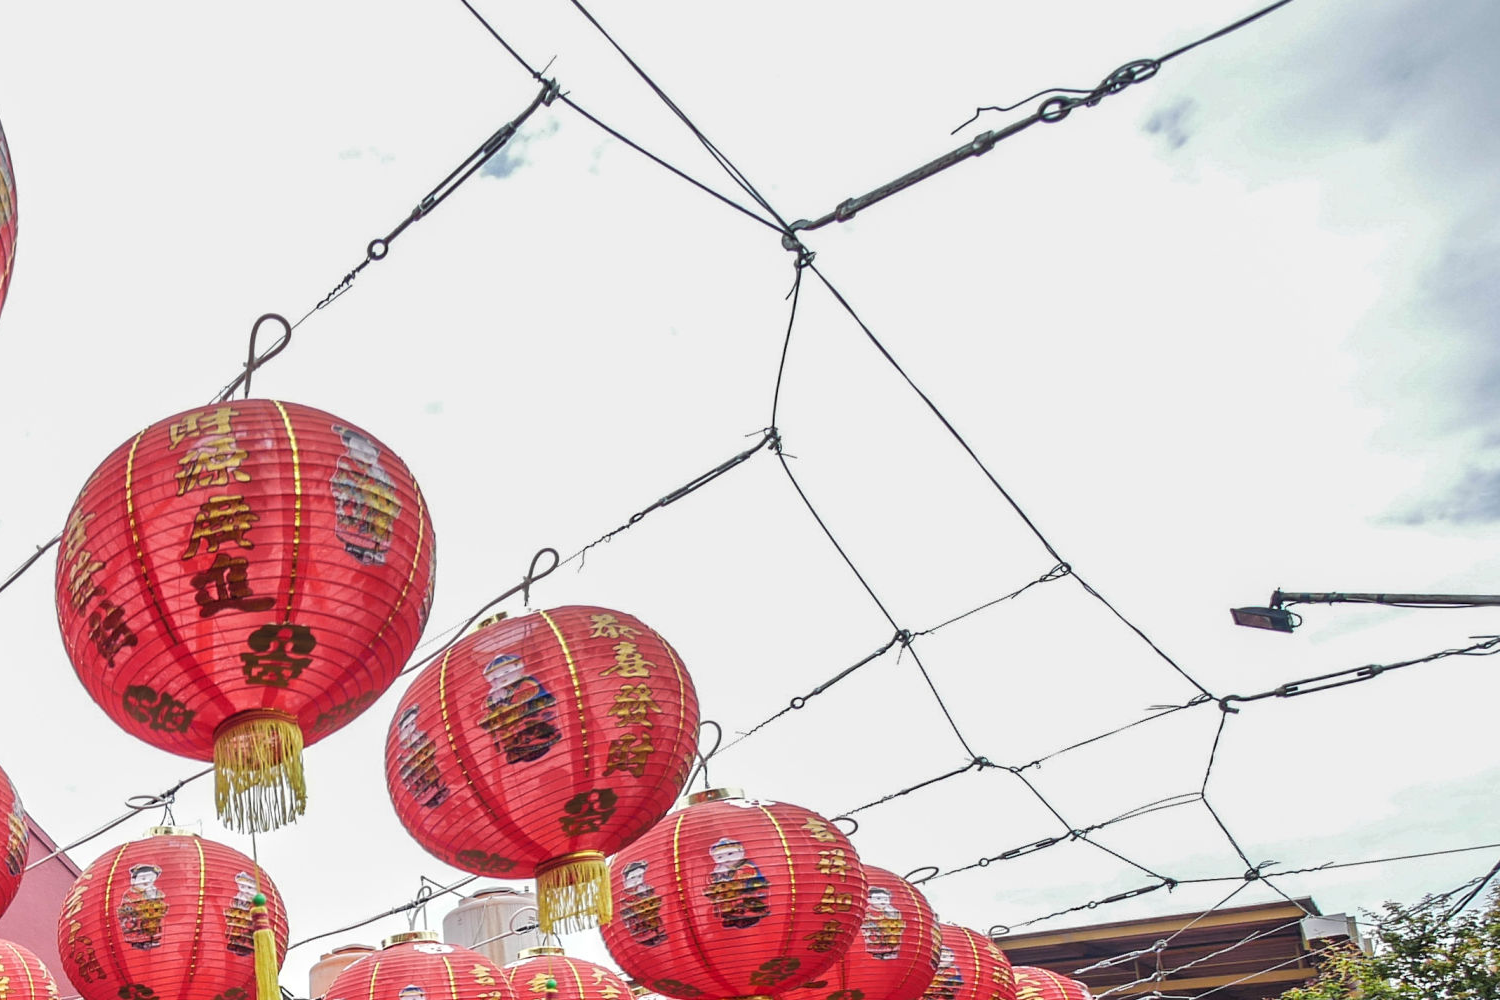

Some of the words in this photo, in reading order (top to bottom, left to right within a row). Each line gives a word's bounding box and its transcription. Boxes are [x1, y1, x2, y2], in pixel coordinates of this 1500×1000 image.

[169, 408, 276, 617] 財源廣進
[589, 613, 663, 778] 恭喜發財
[801, 817, 852, 953] 吉祥如意
